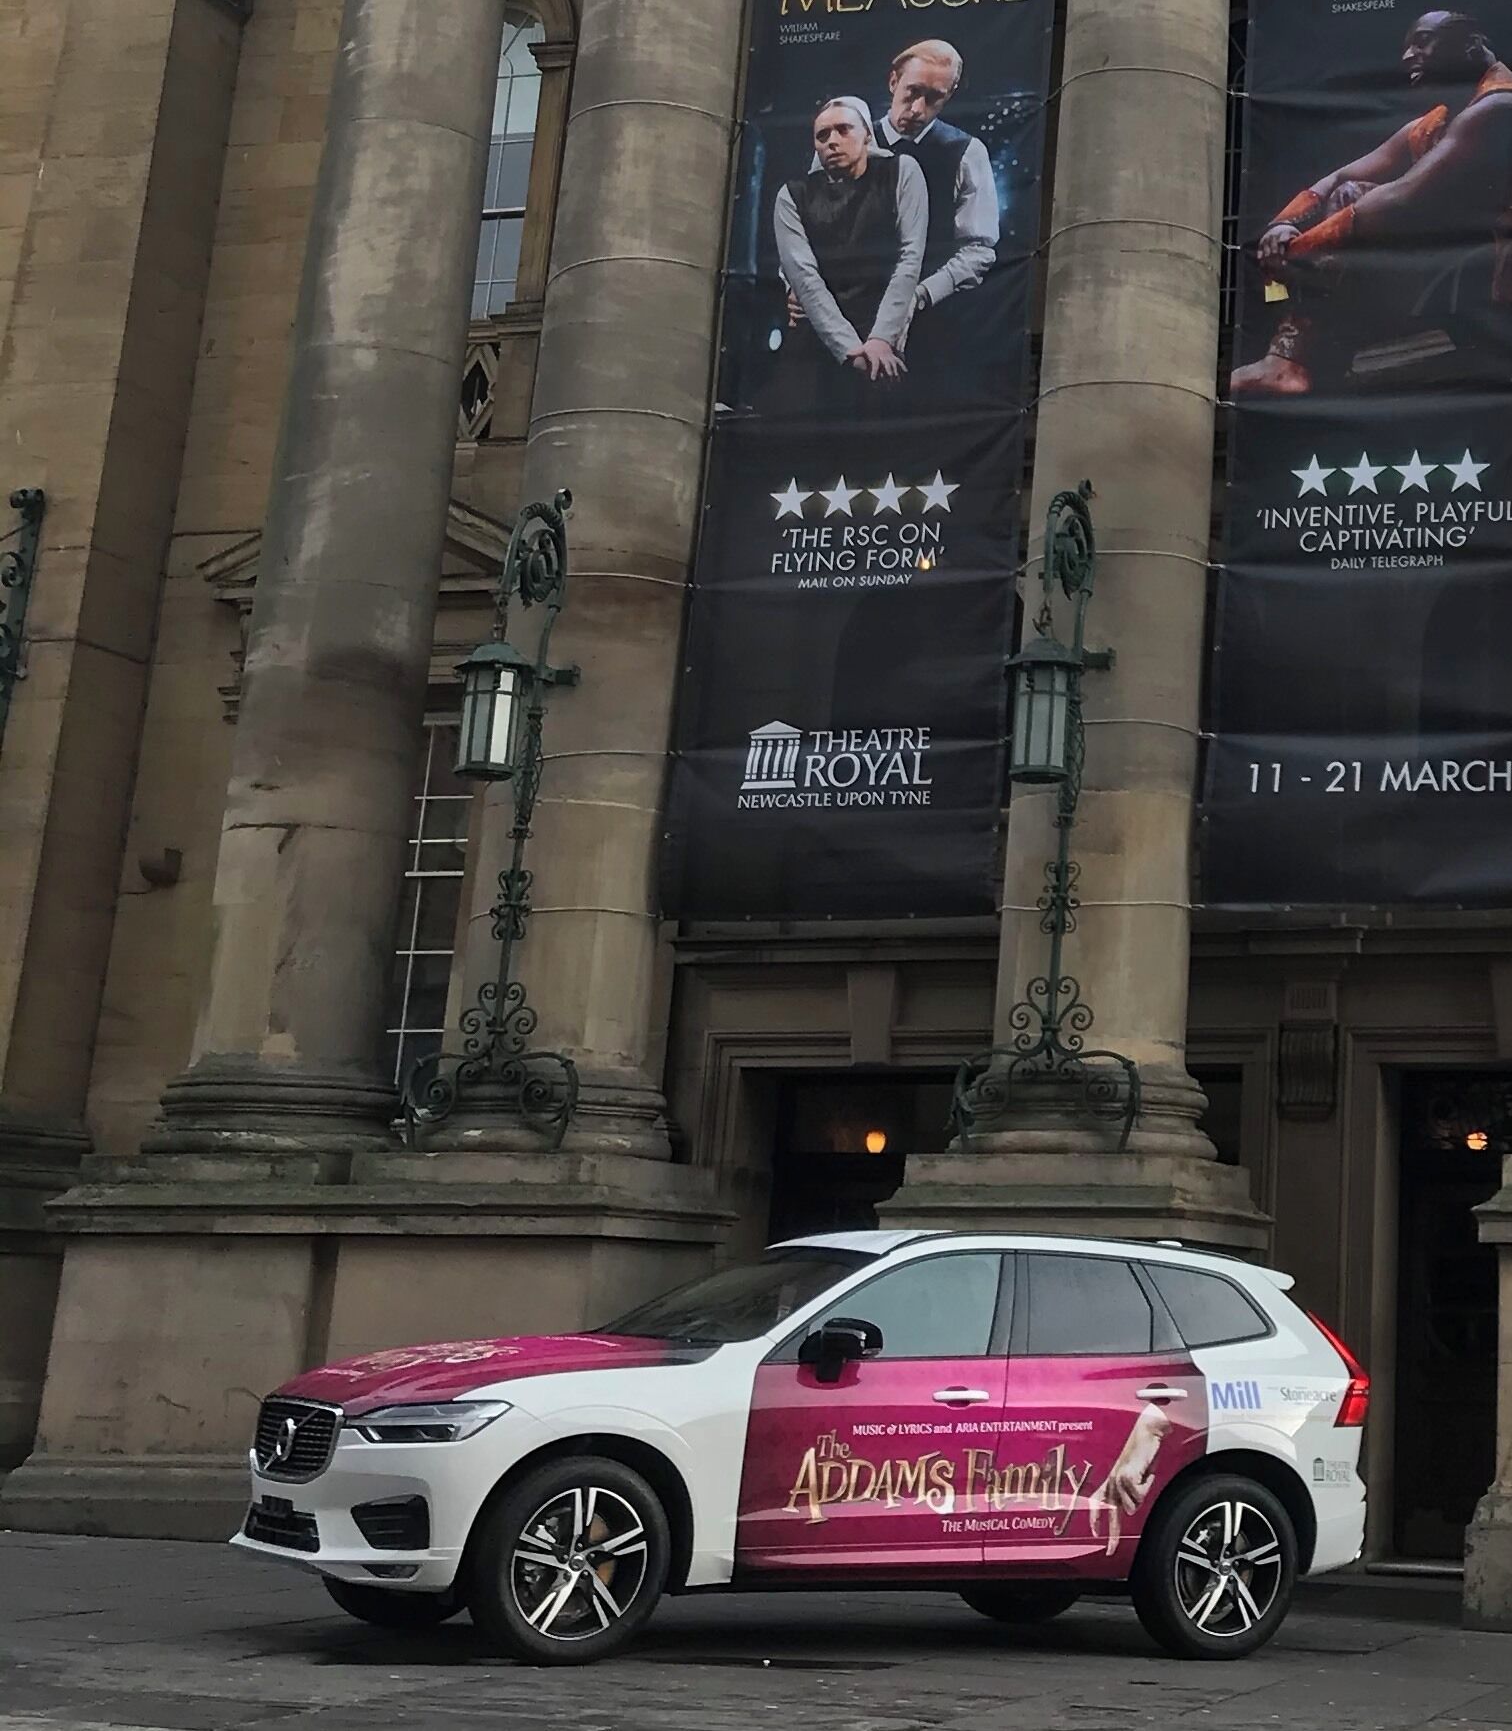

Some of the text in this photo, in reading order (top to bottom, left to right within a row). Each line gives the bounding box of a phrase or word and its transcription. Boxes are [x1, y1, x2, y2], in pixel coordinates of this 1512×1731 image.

[779, 22, 818, 33] WILLIAM
[779, 31, 841, 45] SHAKESPEARE
[843, 524, 889, 546] RSC
[899, 521, 942, 543] ON
[771, 550, 856, 573] FLYING
[1330, 553, 1444, 571] DAILY TELEGRAPH
[798, 573, 913, 589] MAIL ON SUNDAY
[808, 726, 931, 754] THEATRE
[803, 752, 933, 788] ROYAL
[1249, 762, 1282, 794] 11
[1325, 760, 1363, 793] 21
[1379, 759, 1512, 793] MARCH
[737, 790, 931, 809] NEWCASTLE UPON TYNE
[1211, 1381, 1261, 1410] Mill
[852, 1424, 886, 1436] MUSIC
[898, 1423, 932, 1434] LYRICS
[933, 1422, 952, 1434] and
[955, 1422, 979, 1433] ARIA
[1058, 1420, 1093, 1433] present
[816, 1429, 852, 1459] The
[781, 1443, 1094, 1536] ADDAMS Family
[942, 1516, 1056, 1533] THE MUSICAL COMEDY
